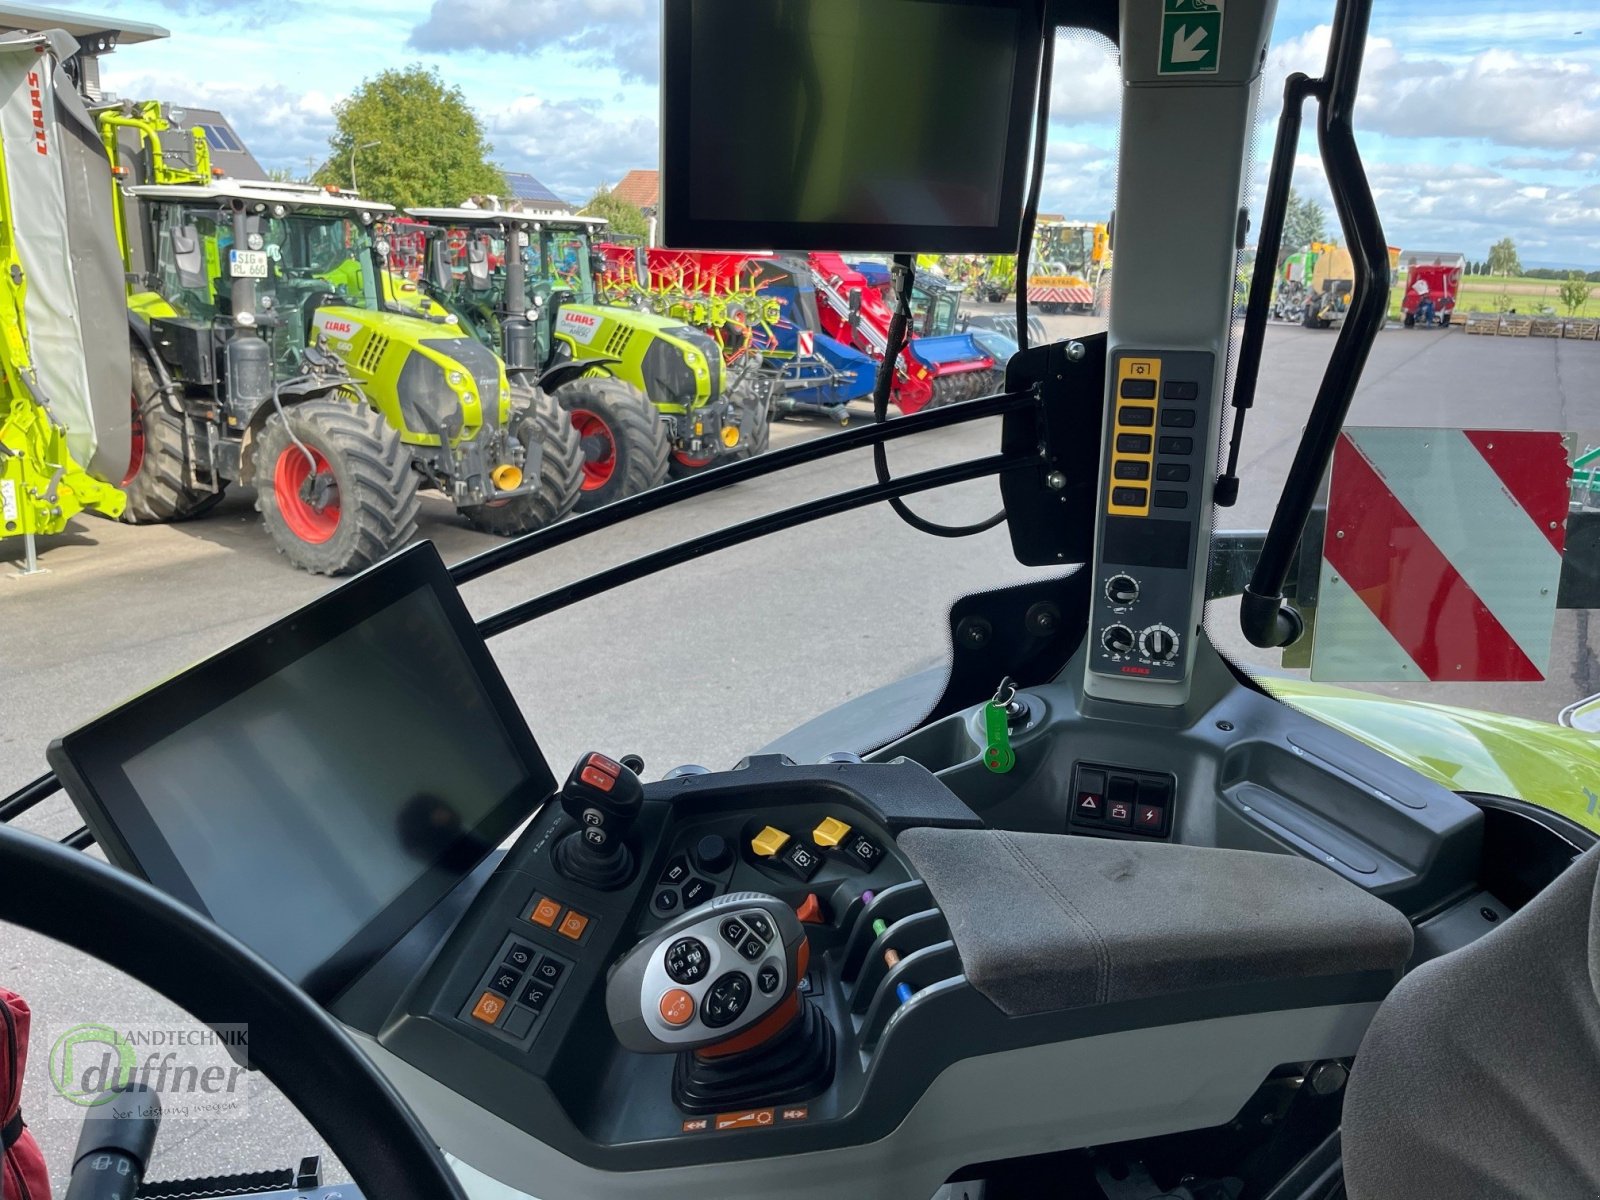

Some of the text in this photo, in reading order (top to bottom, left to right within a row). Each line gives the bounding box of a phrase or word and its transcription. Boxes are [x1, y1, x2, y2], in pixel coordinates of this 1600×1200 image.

[27, 71, 47, 155] CLAAS
[238, 253, 256, 264] SIG
[233, 264, 266, 275] RL 660
[565, 313, 595, 326] CLAAS
[325, 320, 351, 333] CLAAS
[1121, 666, 1151, 675] CLAAS
[586, 814, 599, 825] F3
[589, 831, 602, 843] F4
[676, 944, 687, 955] F7
[687, 950, 701, 963] F10
[673, 960, 684, 971] F9
[687, 965, 698, 977] F8
